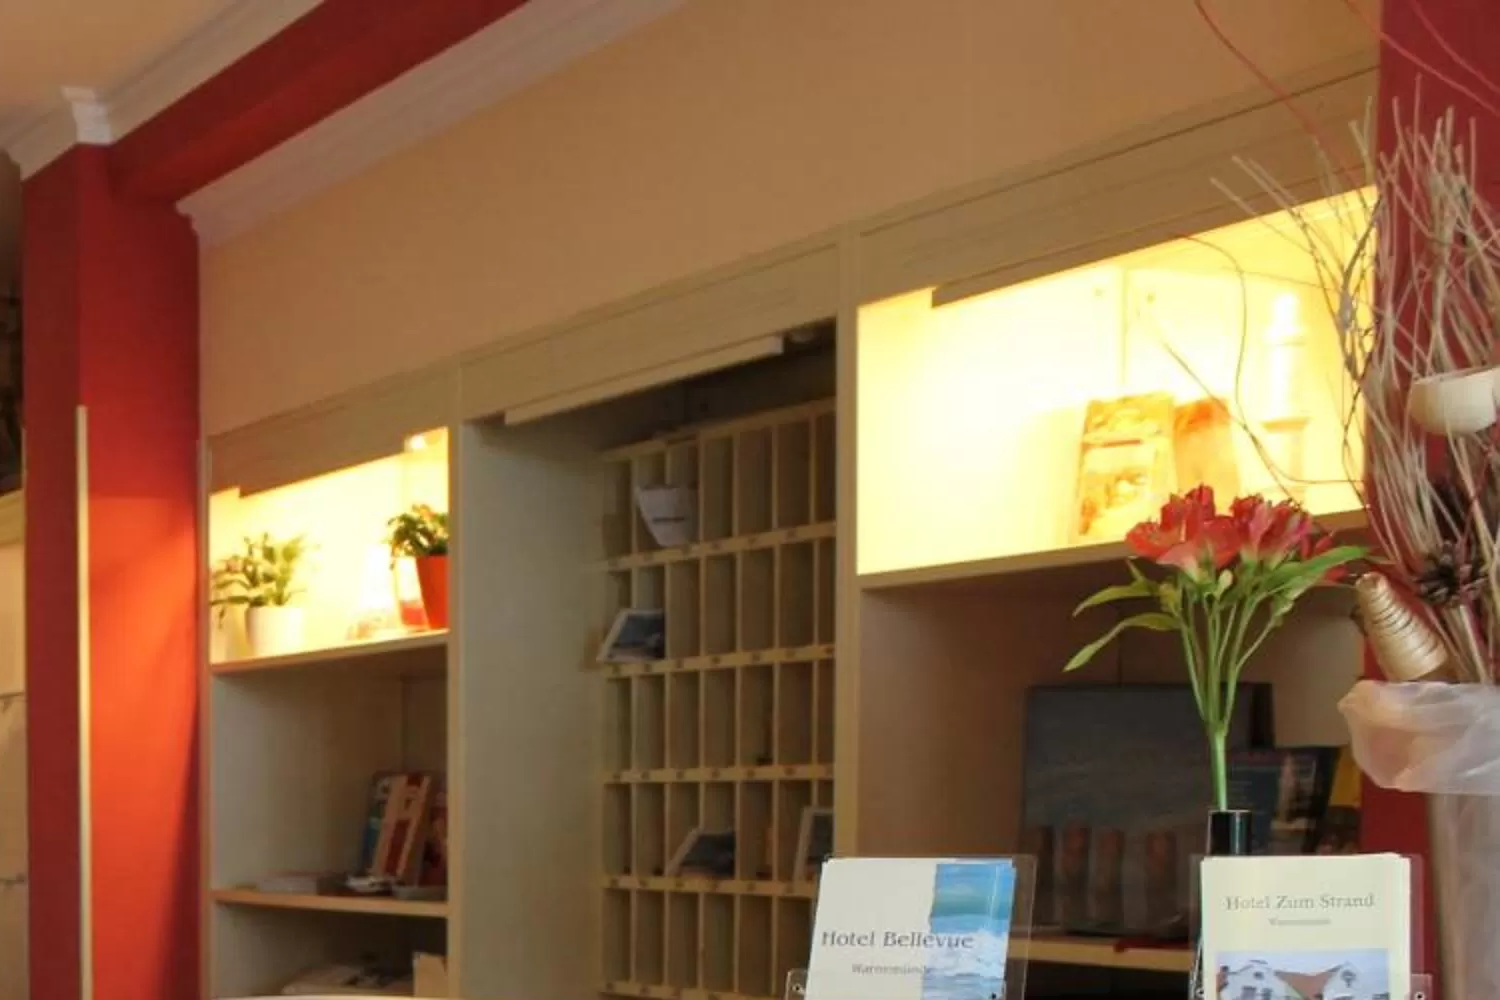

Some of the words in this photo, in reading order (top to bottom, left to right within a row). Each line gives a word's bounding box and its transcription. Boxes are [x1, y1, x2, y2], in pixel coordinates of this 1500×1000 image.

[1225, 895, 1270, 910] Hotel
[1276, 895, 1314, 909] Zum
[1319, 892, 1375, 909] Strand
[821, 930, 876, 948] Hotel
[883, 930, 975, 949] Bellevue
